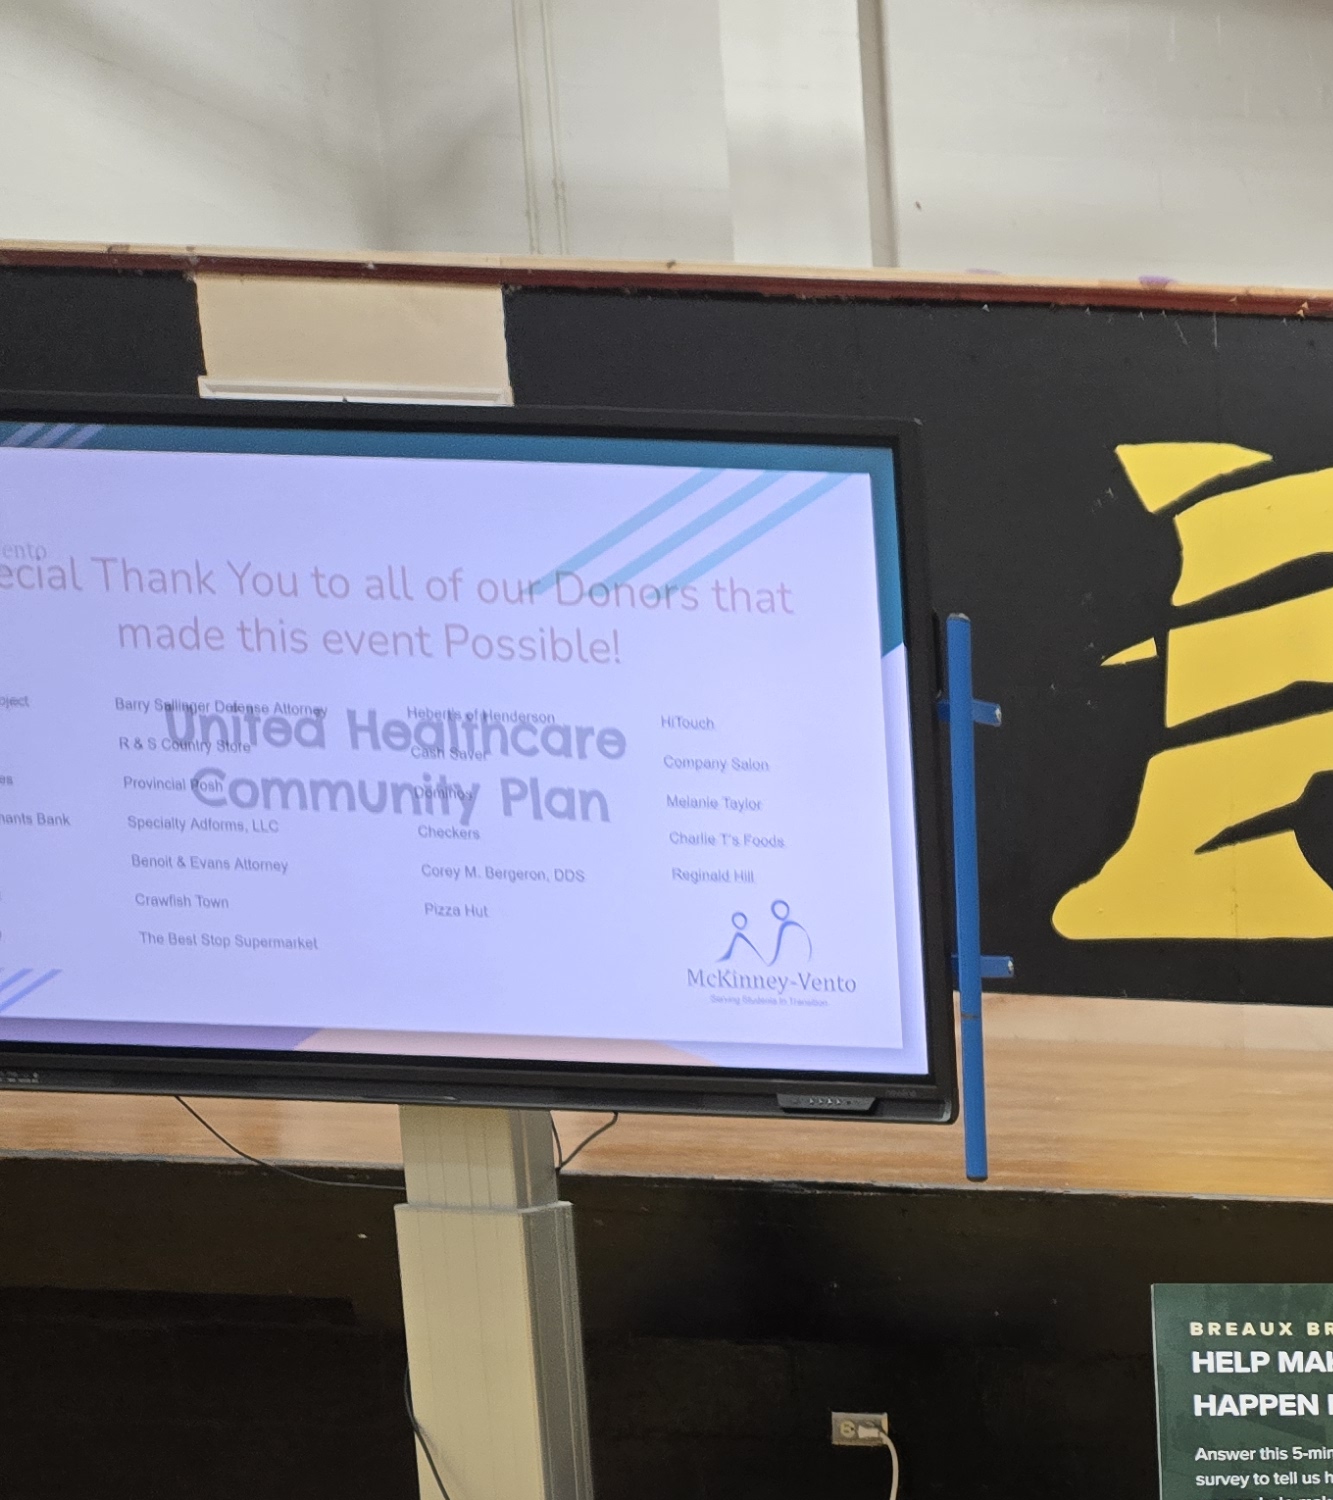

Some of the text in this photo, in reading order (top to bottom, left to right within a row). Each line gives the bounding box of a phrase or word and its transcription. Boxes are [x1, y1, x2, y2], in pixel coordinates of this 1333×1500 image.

[91, 556, 795, 615] Thank You to all of our Donors that
[118, 615, 621, 664] made this event Possible!
[165, 702, 627, 760] United Healthcare
[660, 715, 715, 731] HiTouch
[663, 755, 769, 773] Company Salon
[191, 767, 611, 826] Community Plan
[417, 825, 480, 840] Checkers
[672, 868, 755, 885] Reginald Hill
[135, 893, 229, 909] Crawfish Town
[424, 902, 489, 918] Pizza Hut
[139, 931, 319, 951] The Best Stop Supermarket
[686, 968, 857, 994] McKinney-Vento
[1190, 1322, 1294, 1337] BREAUX
[1192, 1351, 1270, 1373] HELP
[1193, 1394, 1319, 1416] HAPPEN
[1195, 1447, 1256, 1461] Answer
[1260, 1446, 1289, 1460] this
[1196, 1473, 1249, 1489] survey
[1253, 1473, 1270, 1486] to
[1273, 1471, 1298, 1485] tell
[1302, 1474, 1320, 1485] us
